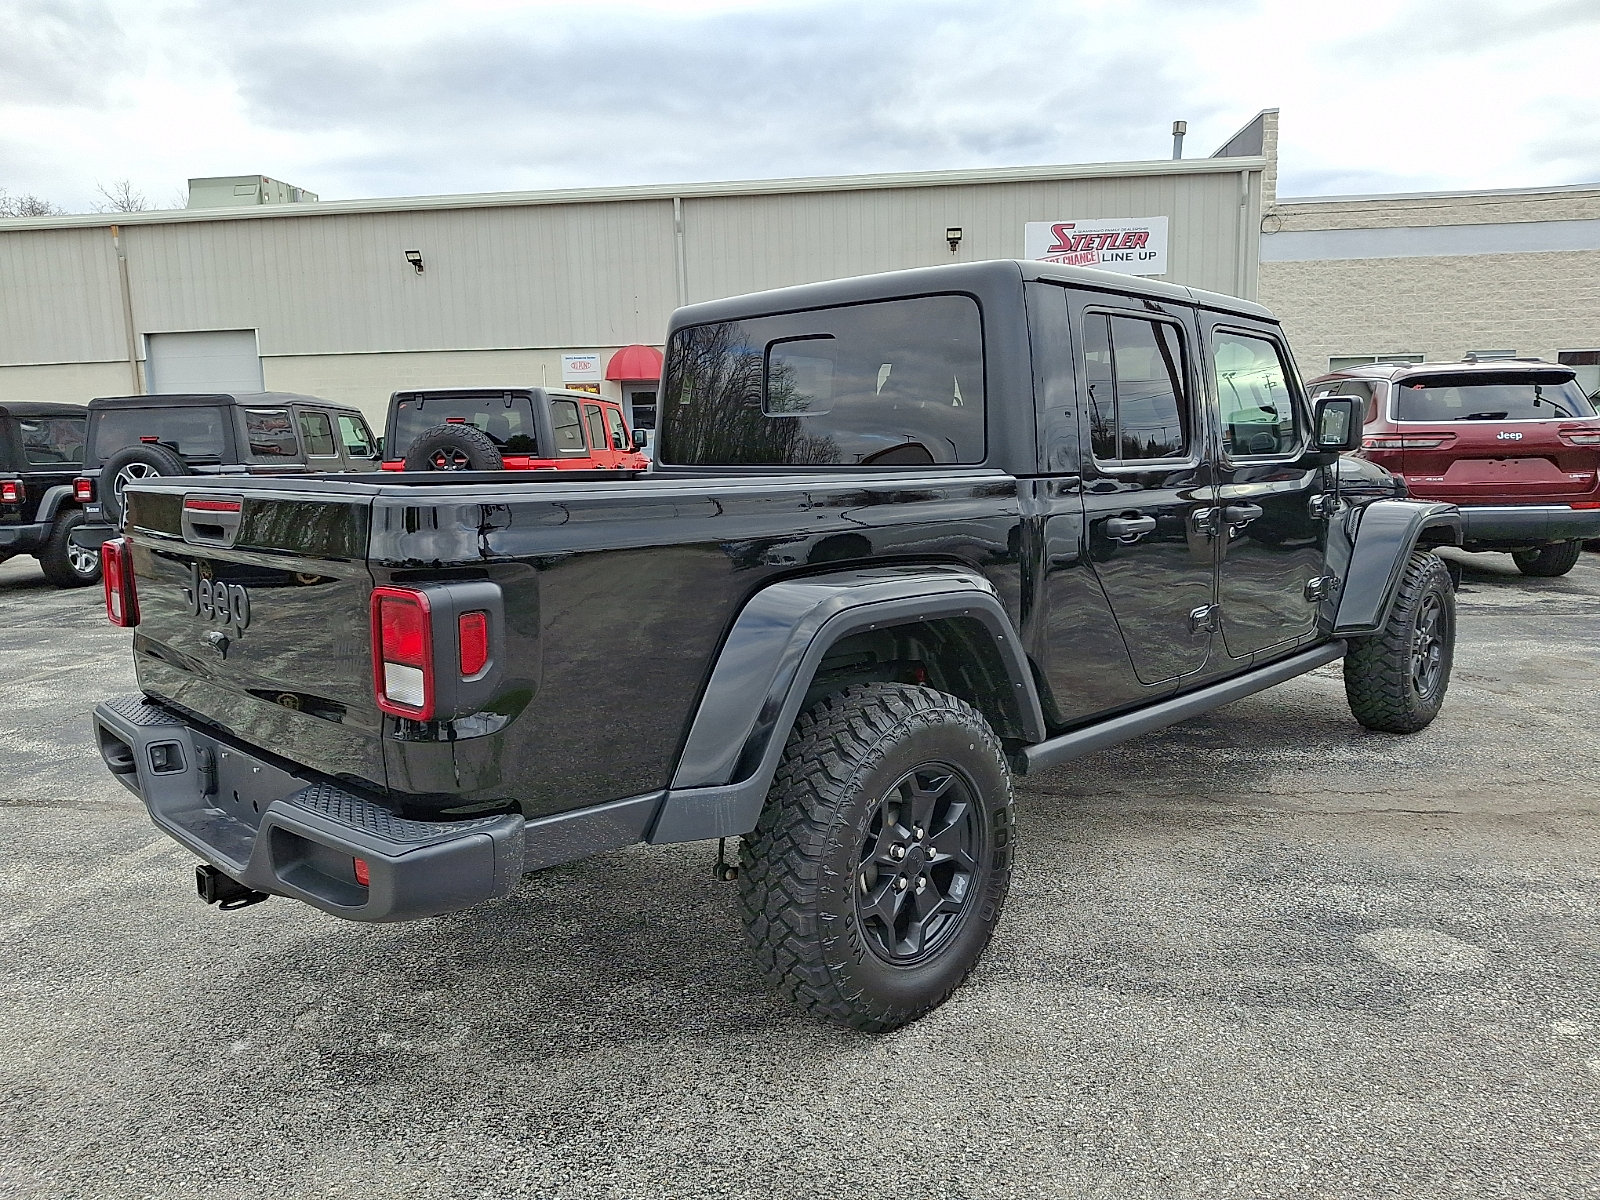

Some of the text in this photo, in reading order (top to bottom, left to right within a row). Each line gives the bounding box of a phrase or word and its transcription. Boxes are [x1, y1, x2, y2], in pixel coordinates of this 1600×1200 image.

[1047, 223, 1150, 253] STETLER
[1062, 251, 1096, 266] CHANCE
[1102, 251, 1157, 262] LINE UP
[1496, 431, 1523, 440] Jeep
[182, 562, 250, 638] Jeep
[978, 806, 1008, 922] COSMO
